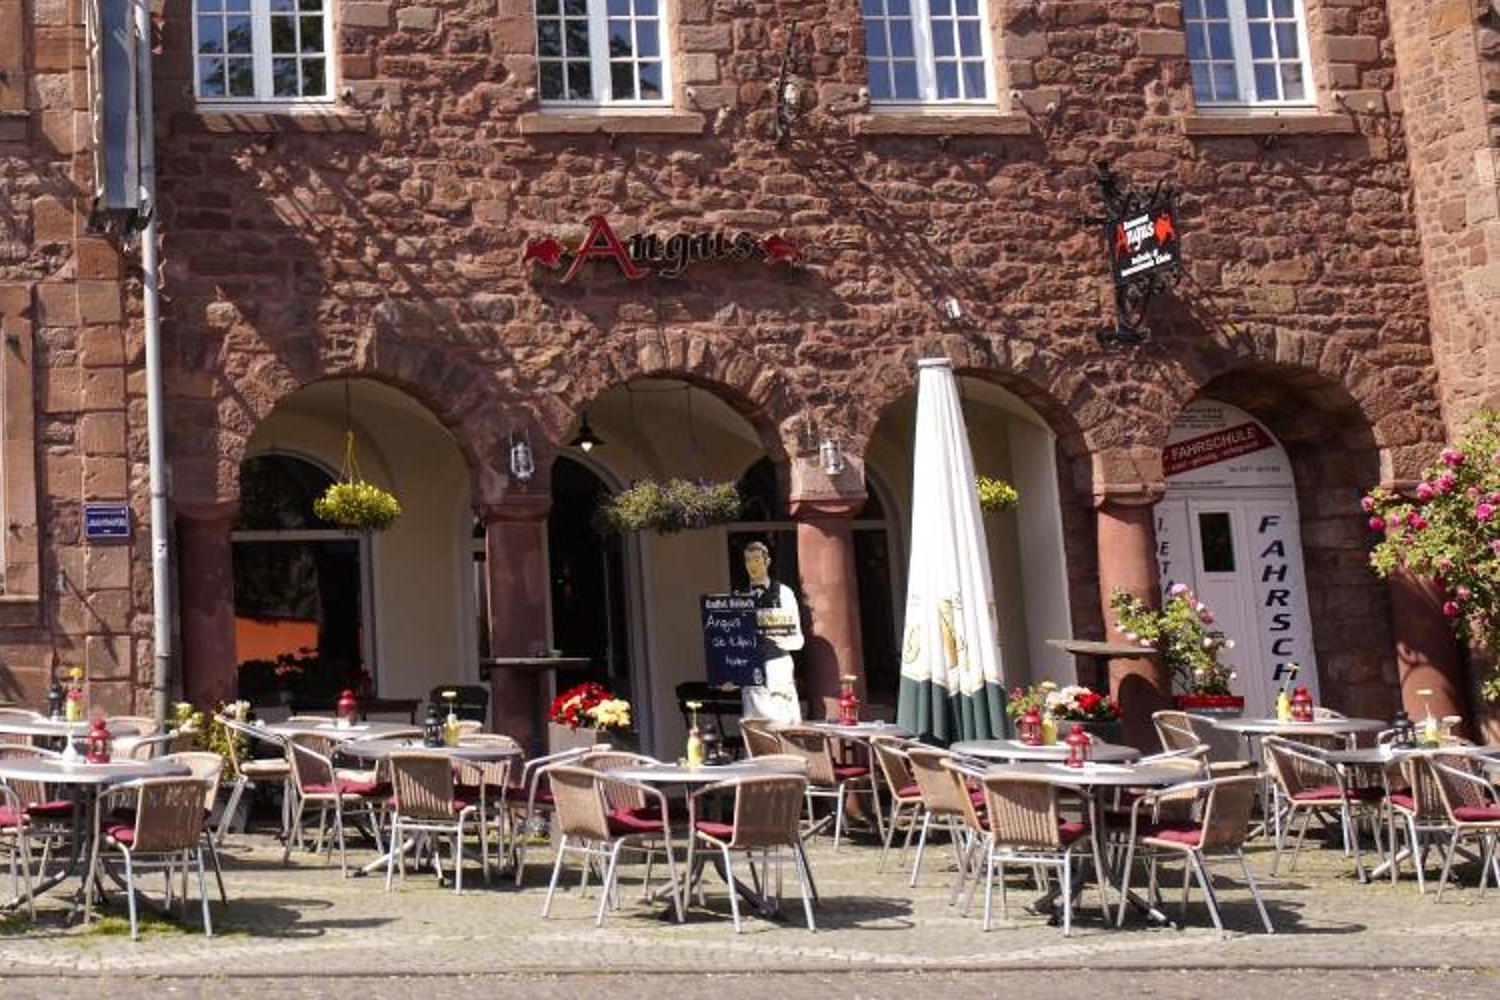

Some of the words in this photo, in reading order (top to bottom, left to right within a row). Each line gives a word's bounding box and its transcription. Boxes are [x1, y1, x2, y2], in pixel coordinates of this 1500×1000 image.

[560, 215, 756, 284] Angus
[1171, 427, 1253, 461] FAHRSCHULE
[1258, 516, 1298, 694] FAHRSCH
